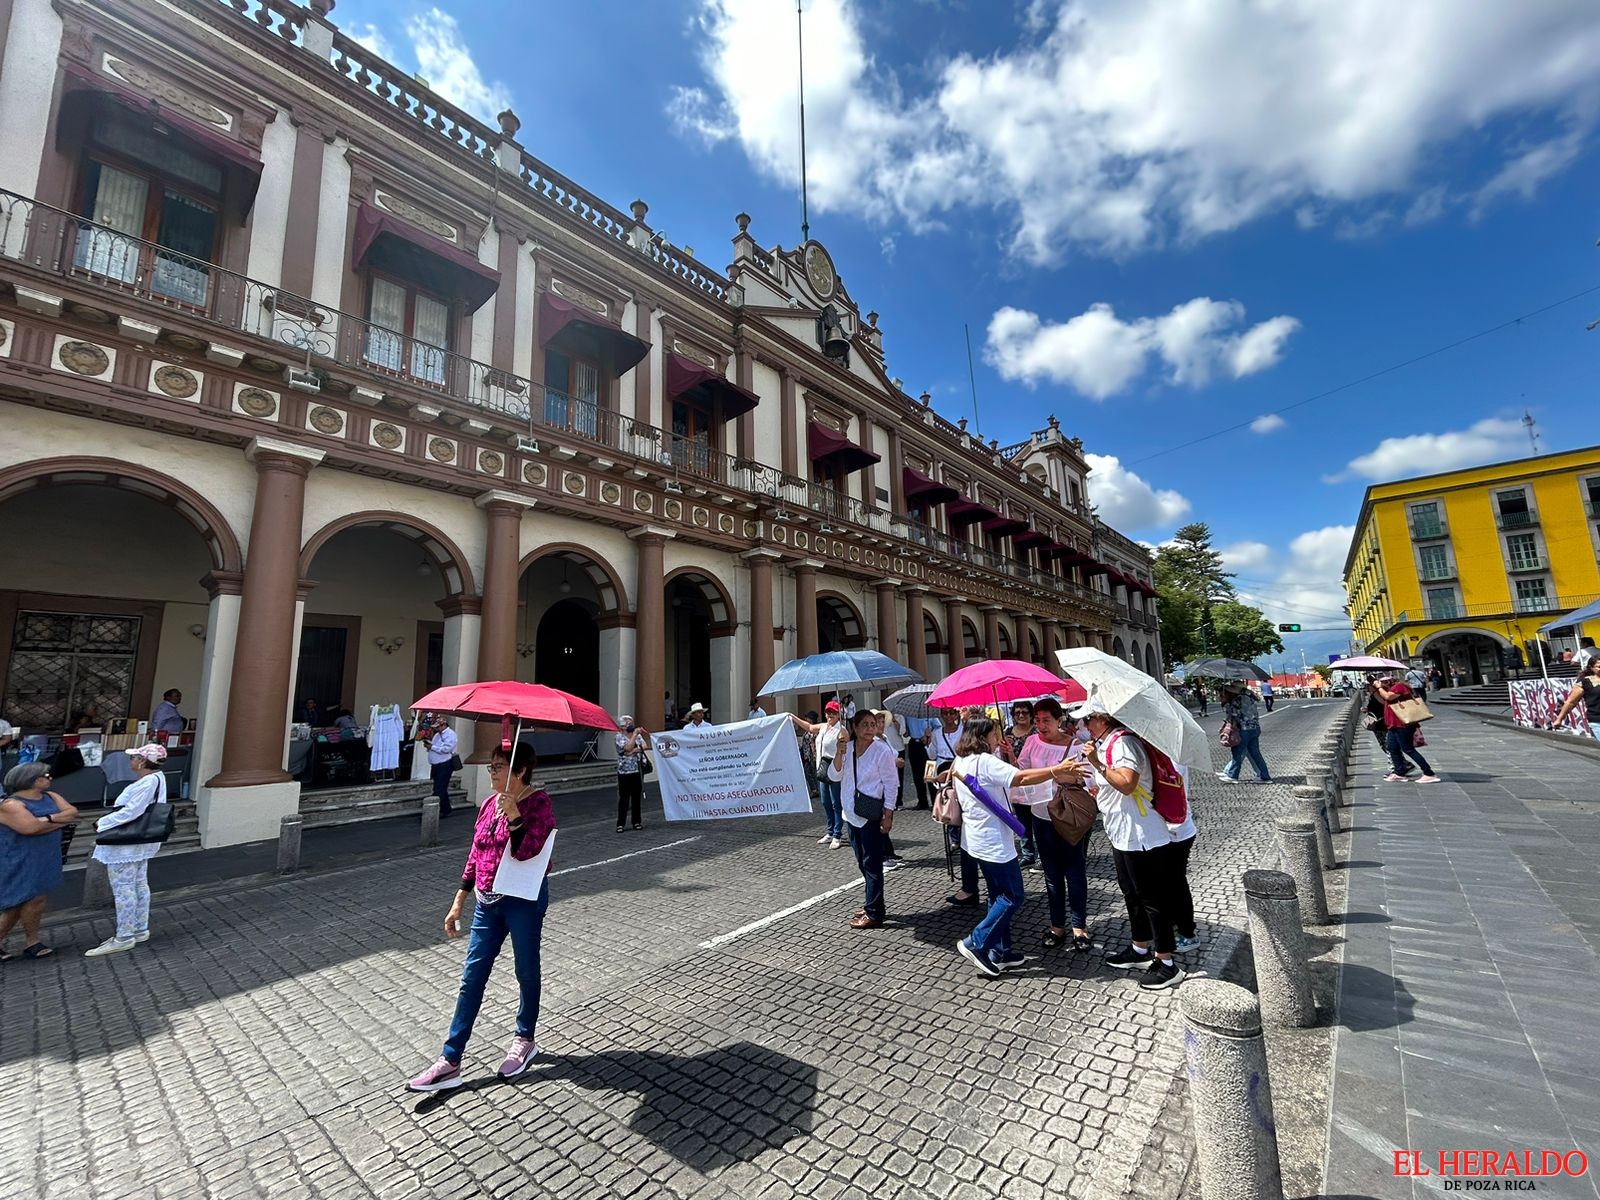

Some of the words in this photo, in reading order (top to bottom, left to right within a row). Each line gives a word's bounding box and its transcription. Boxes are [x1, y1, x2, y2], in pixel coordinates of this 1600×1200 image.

[715, 753, 748, 761] GOBERNADOR
[690, 792, 725, 802] TENEMOS
[727, 784, 794, 799] ASEGURADORA!
